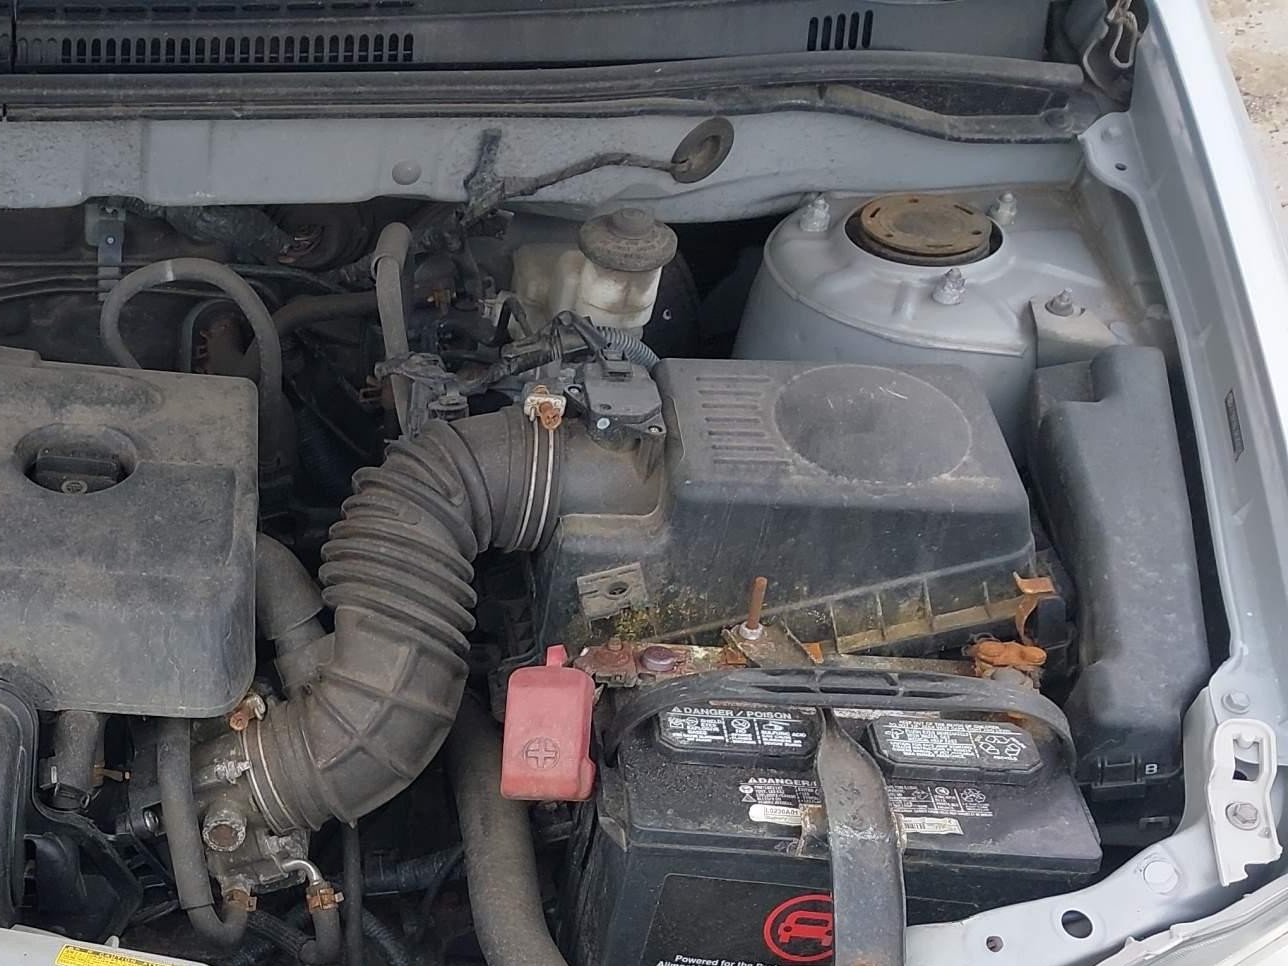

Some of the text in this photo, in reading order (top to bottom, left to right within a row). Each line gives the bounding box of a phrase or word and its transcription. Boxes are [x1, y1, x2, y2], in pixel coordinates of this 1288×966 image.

[683, 706, 734, 717] DANGER
[746, 710, 792, 720] POISON
[674, 954, 719, 966] Powered
